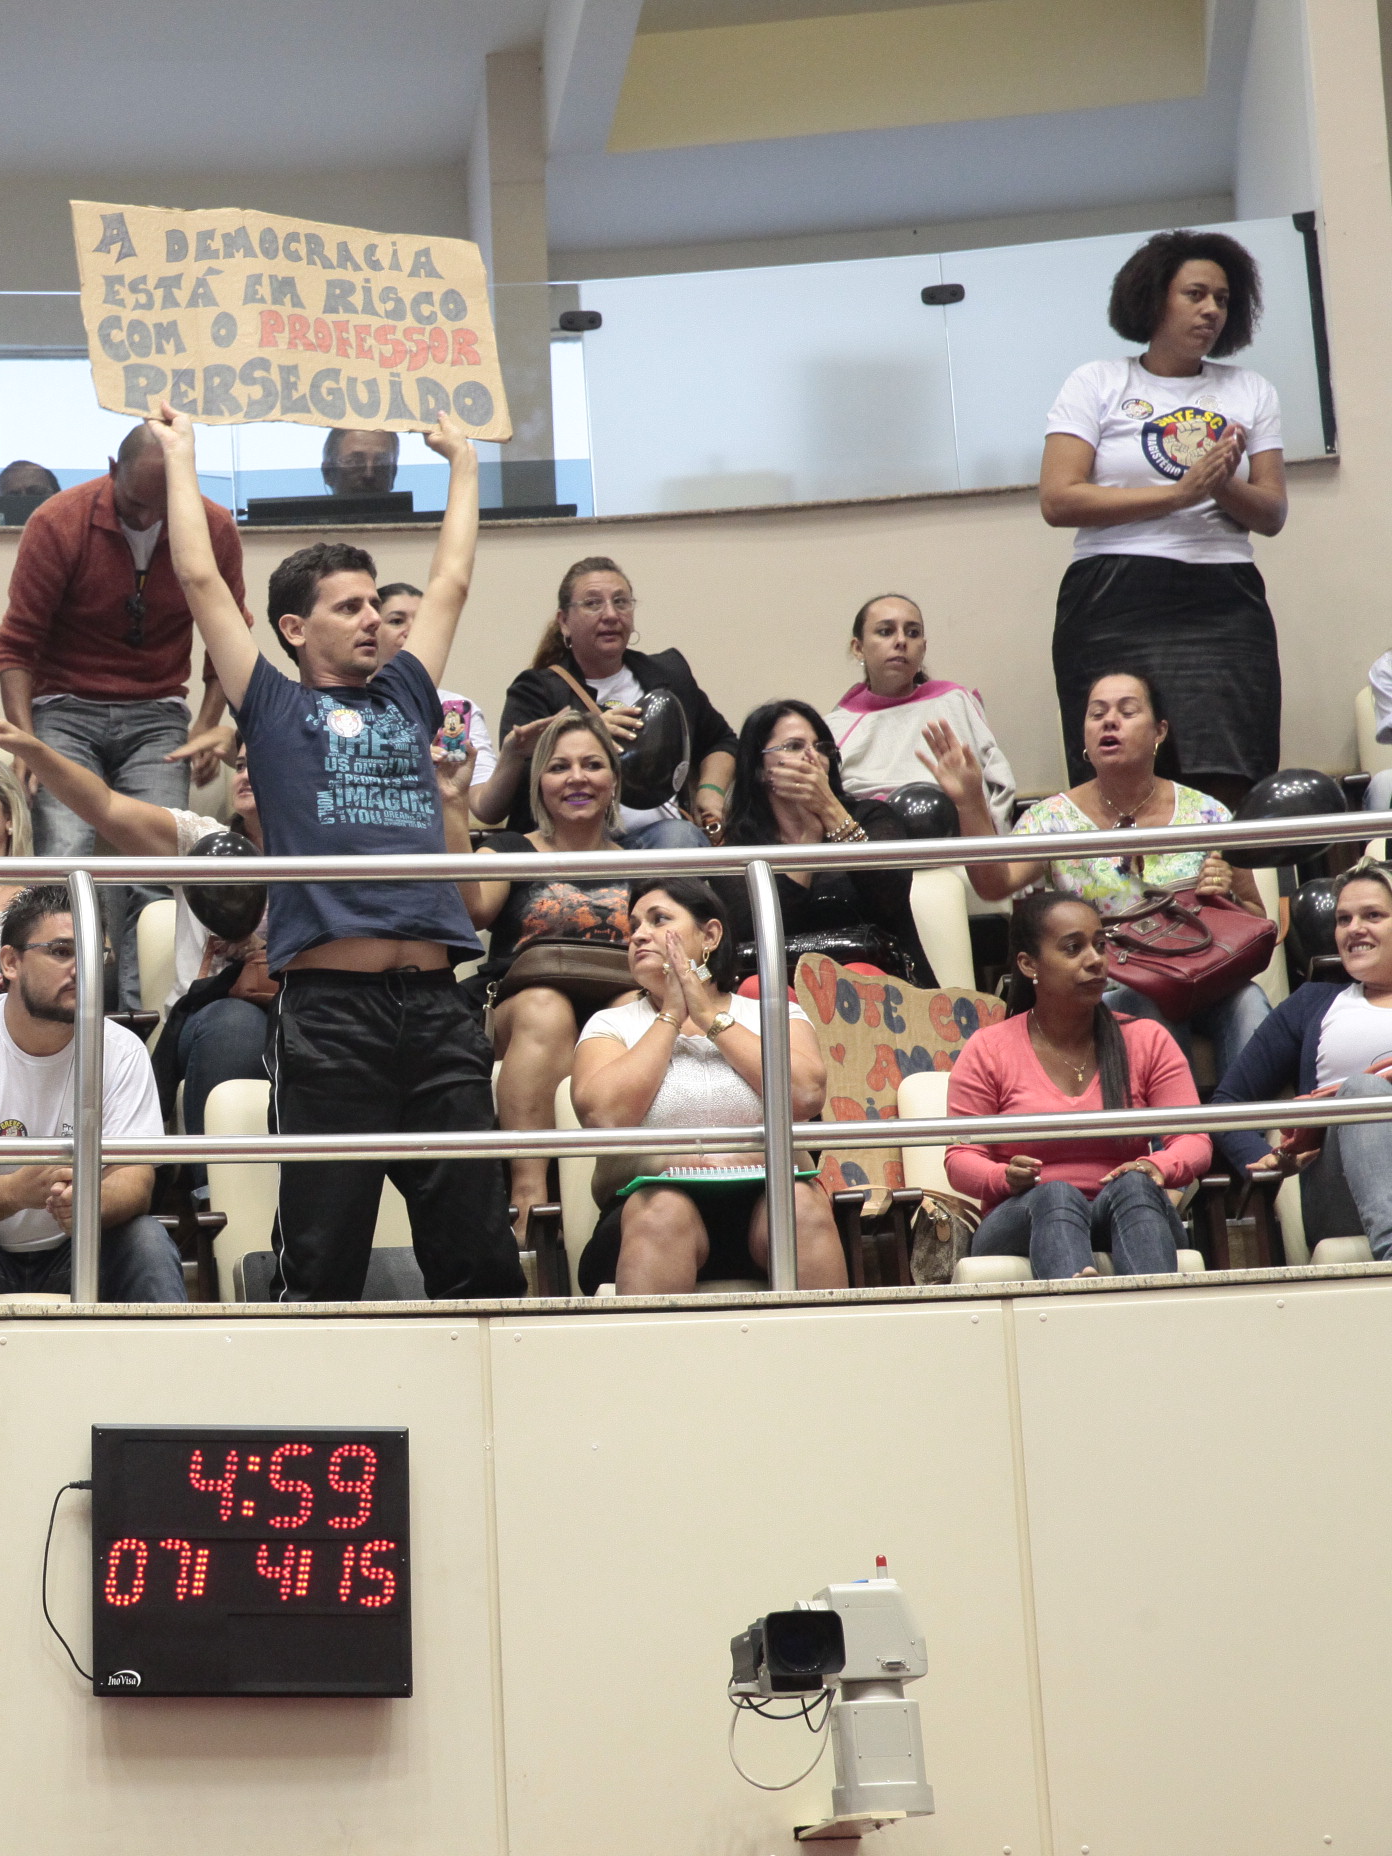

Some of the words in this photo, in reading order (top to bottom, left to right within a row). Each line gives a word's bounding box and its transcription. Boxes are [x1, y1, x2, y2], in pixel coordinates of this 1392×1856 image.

[92, 211, 138, 264] A
[102, 266, 226, 311] ESTÁ
[242, 272, 307, 310] EM
[97, 314, 188, 363] COM
[210, 311, 239, 349] O
[258, 309, 483, 372] PROFESSOR
[324, 756, 350, 773] US
[335, 784, 435, 815] IMAGINE
[346, 808, 383, 825] YOU
[800, 957, 907, 1035] VOTE
[188, 1443, 378, 1529] 4:59
